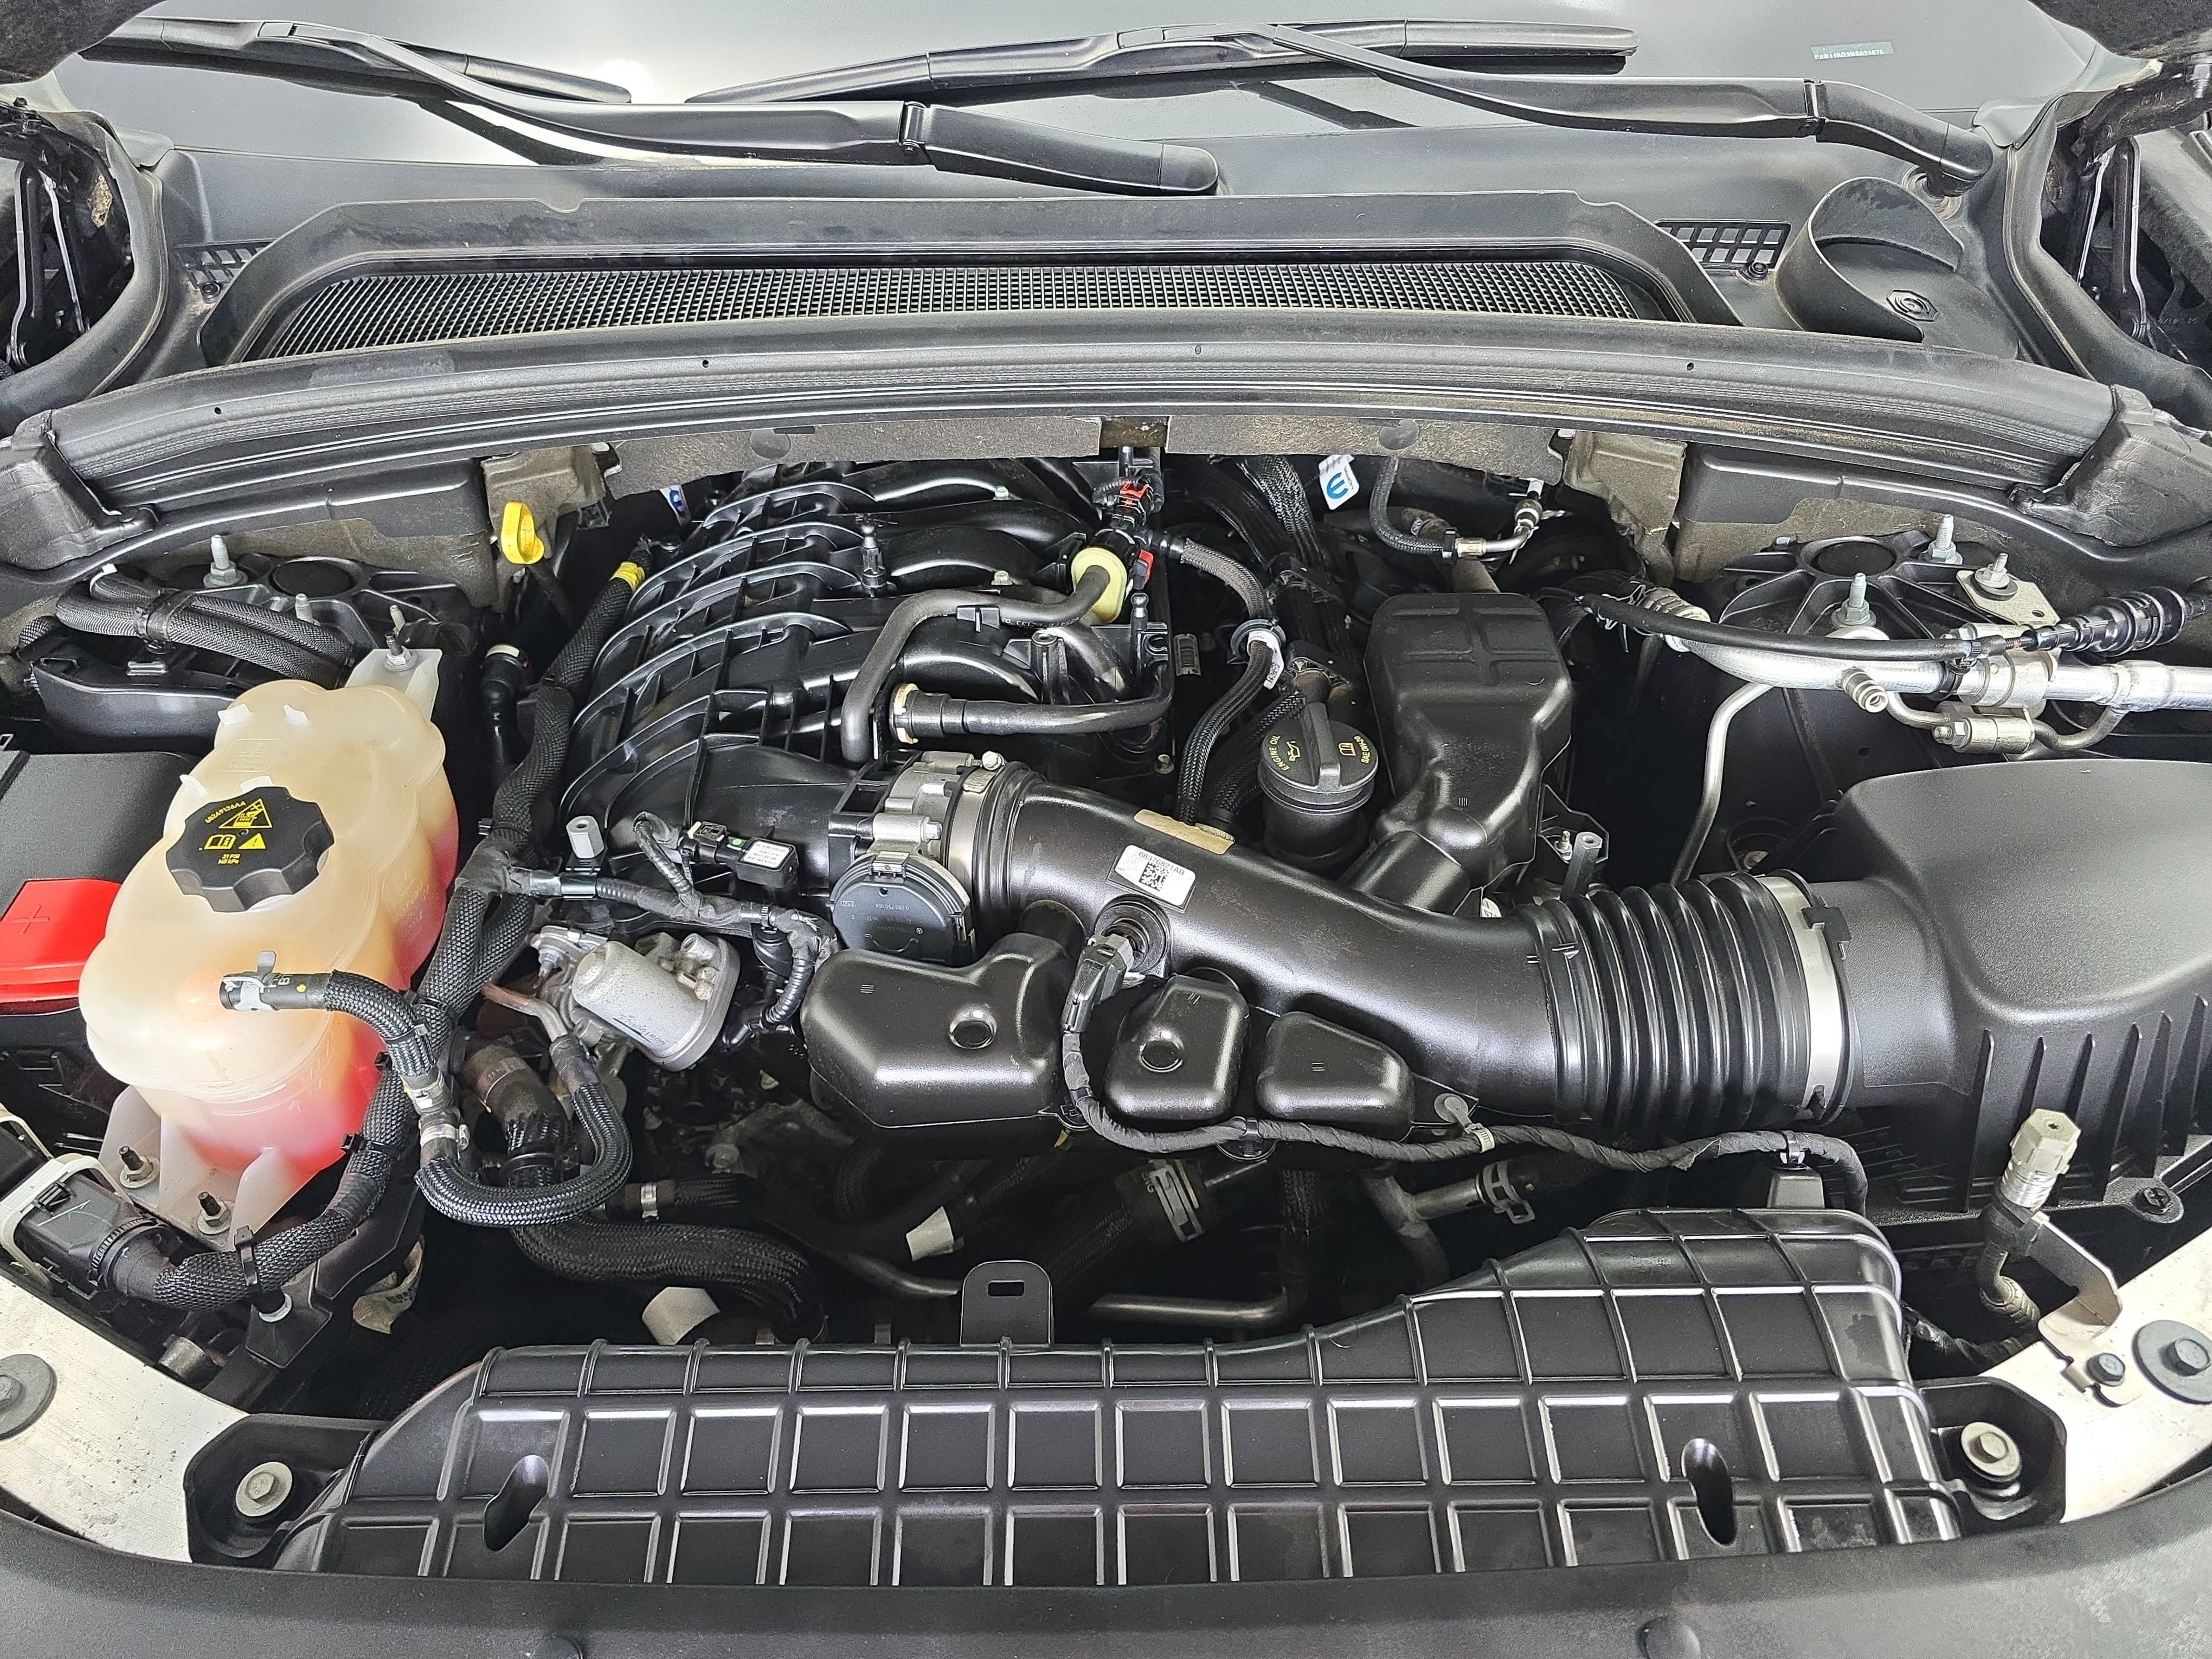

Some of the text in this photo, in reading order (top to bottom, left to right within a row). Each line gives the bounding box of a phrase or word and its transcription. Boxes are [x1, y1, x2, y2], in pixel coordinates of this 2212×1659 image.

[1269, 735, 1290, 771] ENGINE OIL
[1354, 736, 1371, 764] SAE 0W-20
[1138, 851, 1185, 876] 68376821AB
